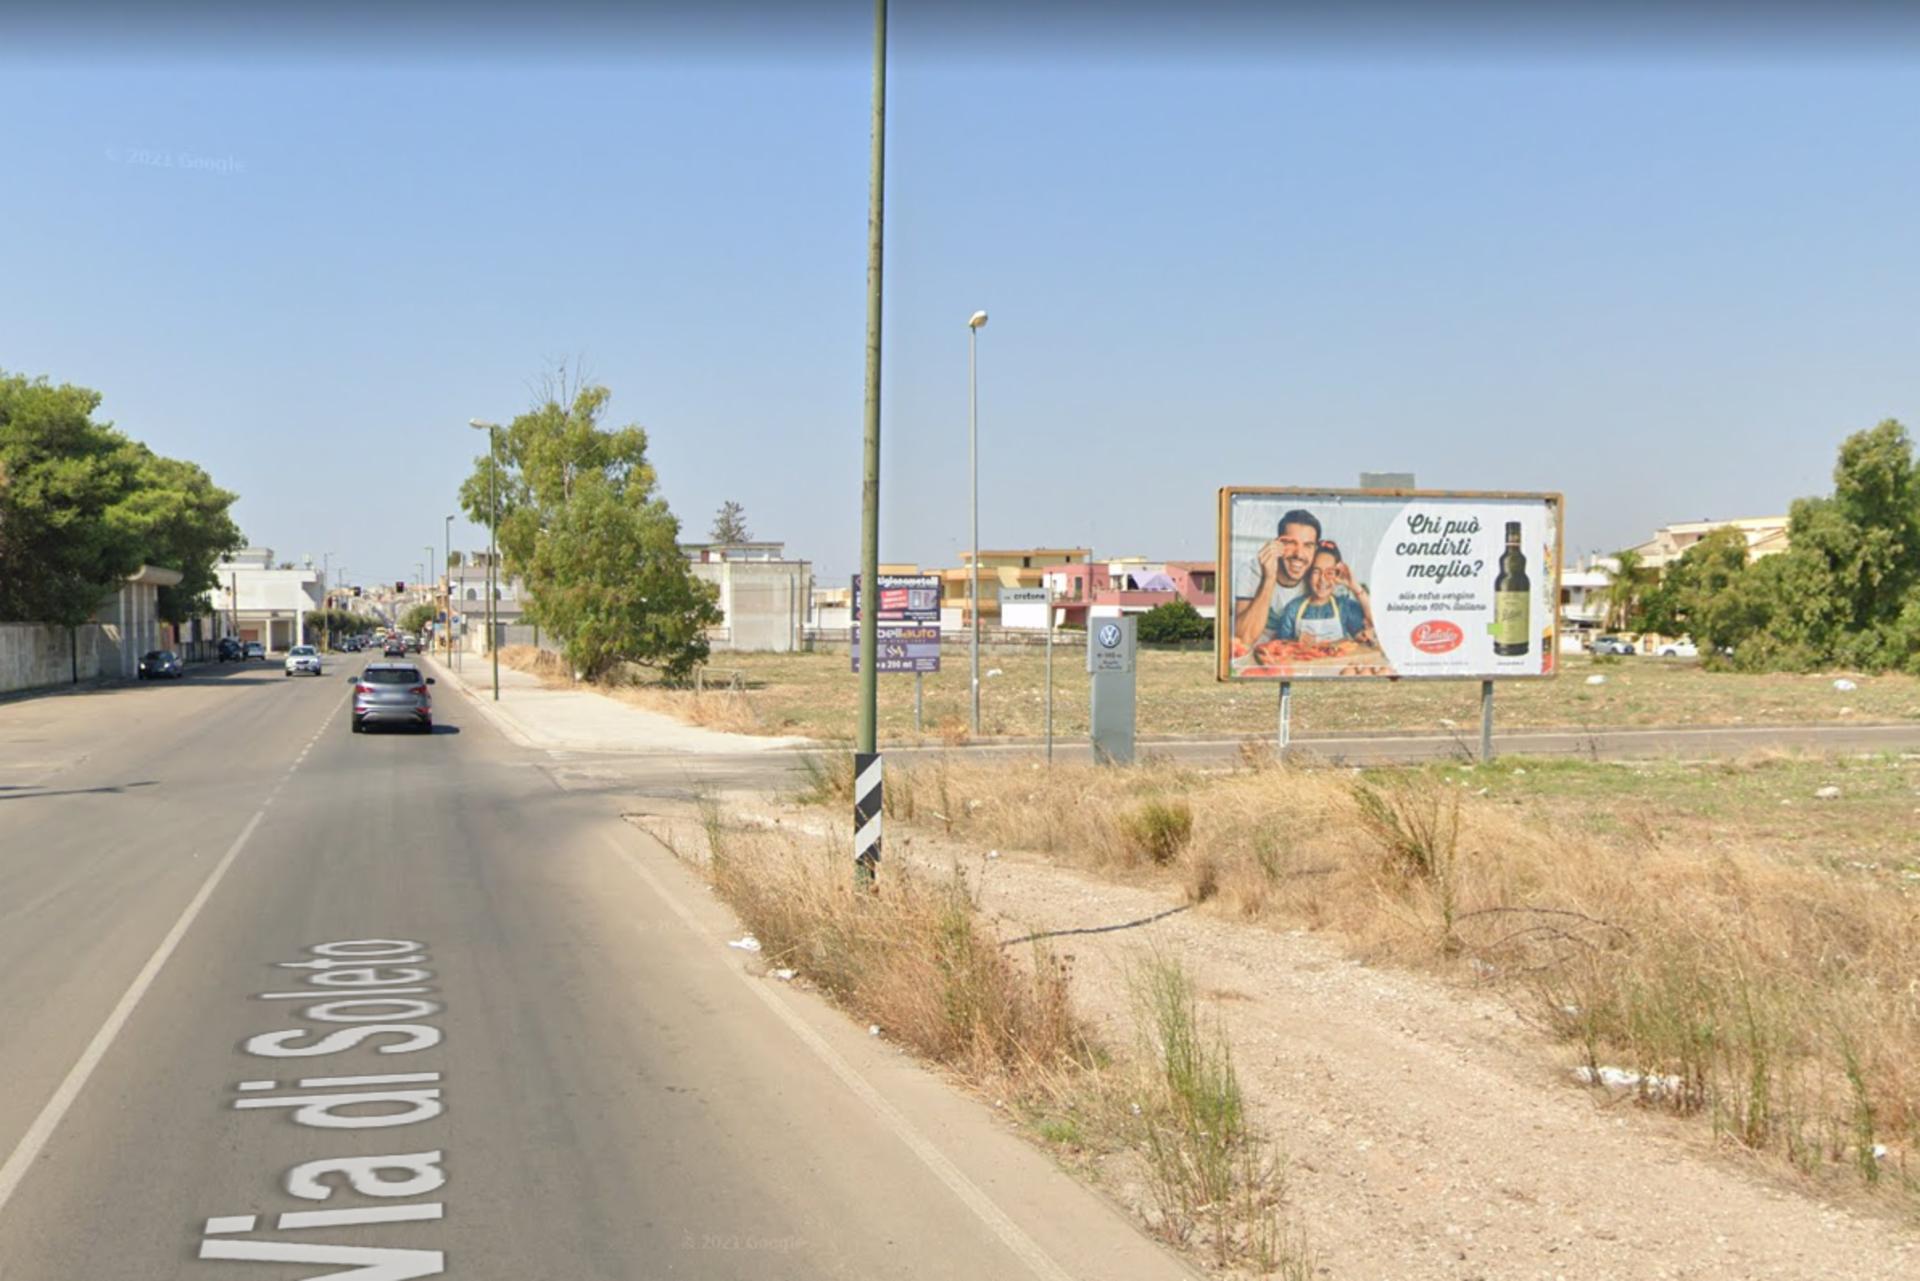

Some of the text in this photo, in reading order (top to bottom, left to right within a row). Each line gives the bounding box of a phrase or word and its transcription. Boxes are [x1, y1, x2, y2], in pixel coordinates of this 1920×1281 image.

[1407, 513, 1482, 538] Chi può
[1395, 538, 1472, 556] condirti
[1406, 560, 1484, 584] meglio?
[1387, 603, 1428, 614] biologico
